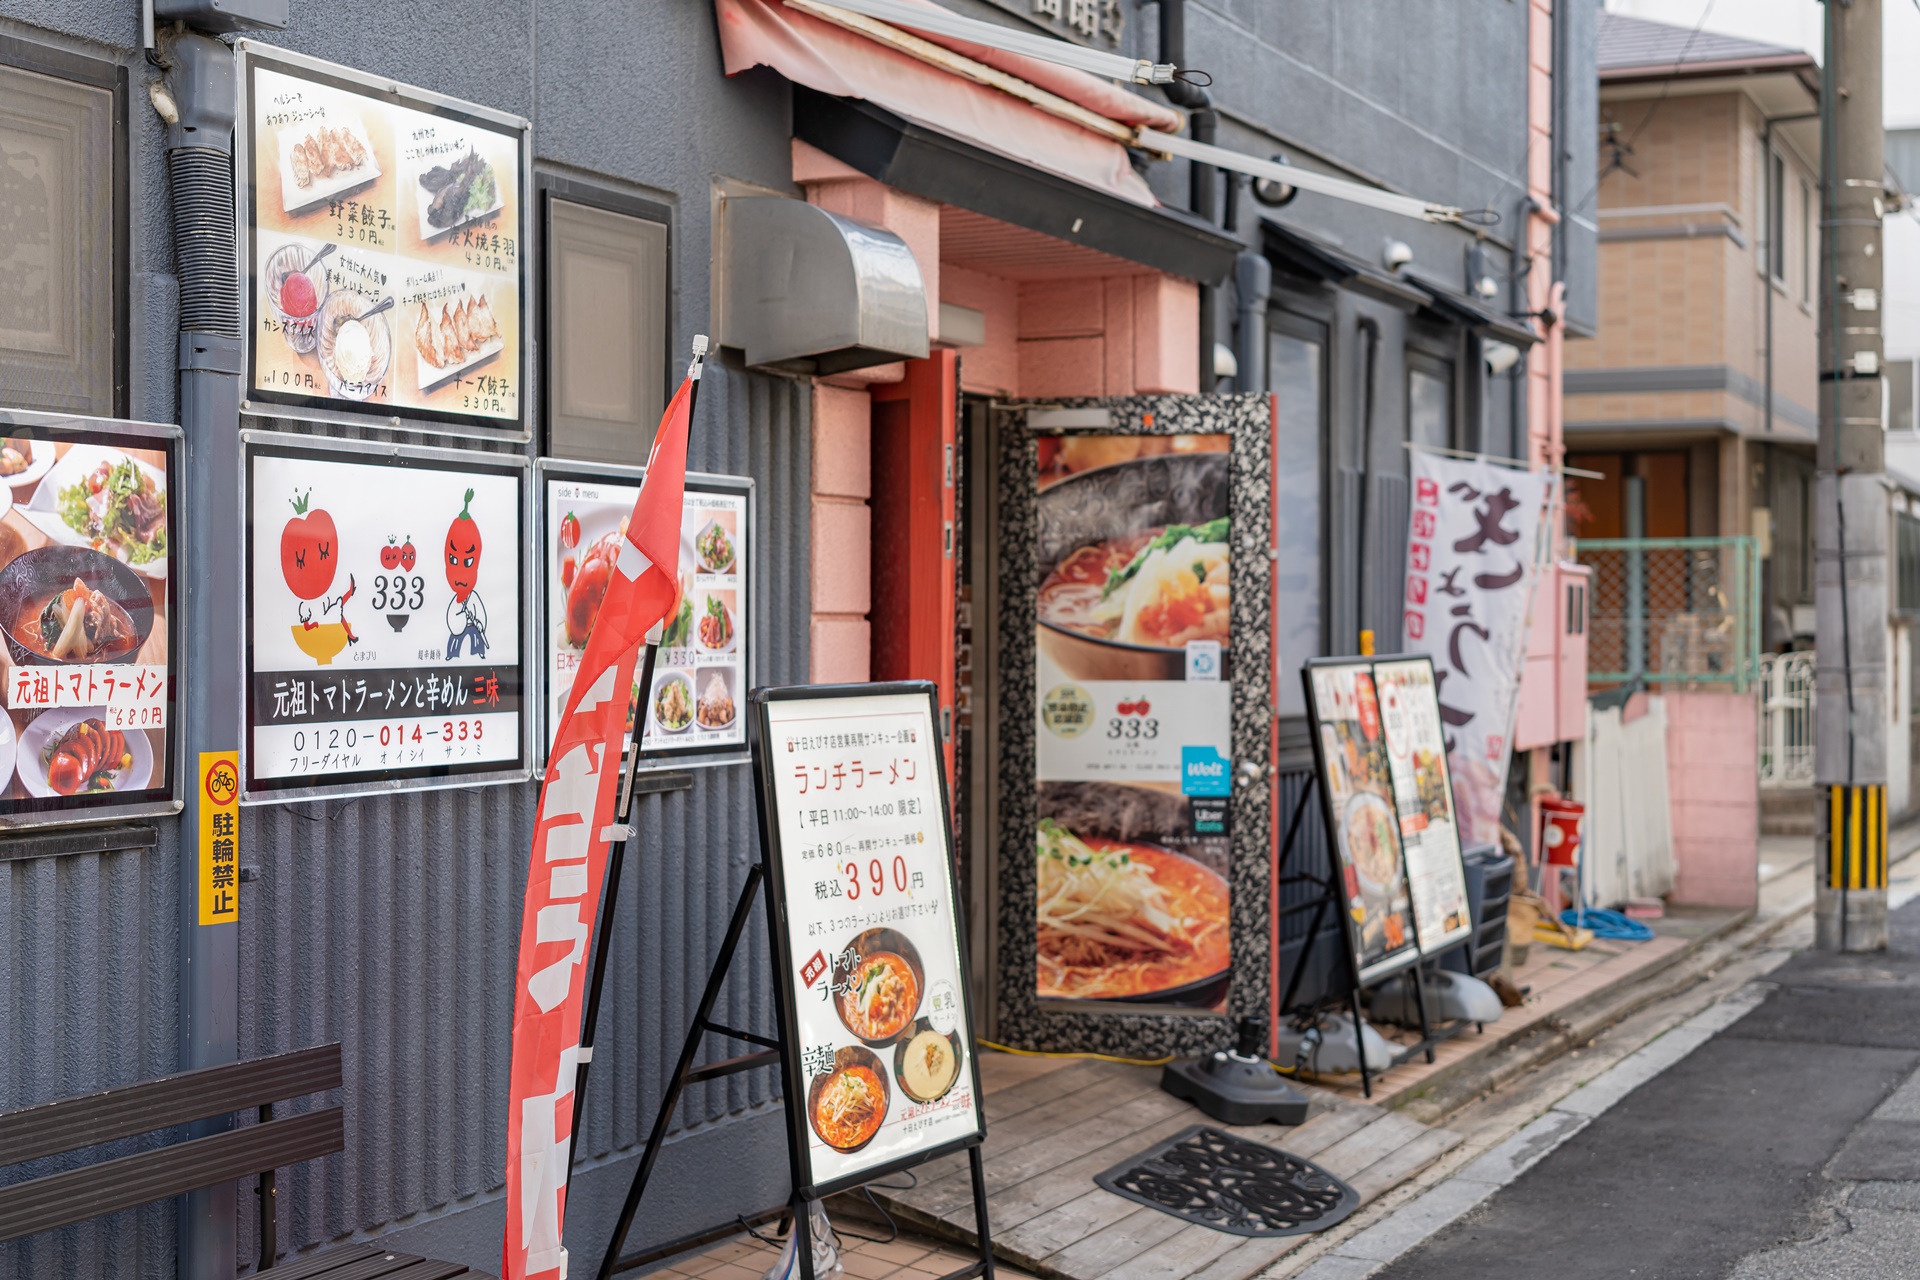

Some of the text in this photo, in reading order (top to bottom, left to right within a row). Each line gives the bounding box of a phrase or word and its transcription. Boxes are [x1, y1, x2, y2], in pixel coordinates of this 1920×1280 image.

[329, 199, 391, 230] 野菜餃子
[263, 317, 315, 338] カシスアイス
[557, 486, 599, 499] side menu
[371, 574, 425, 611] 333
[16, 668, 163, 704] 元祖トマトラーメン
[1106, 718, 1159, 740] 333
[290, 752, 361, 773] フリーダイヤル
[794, 758, 916, 794] ランチラーメン
[1187, 761, 1223, 777] Wolt
[212, 812, 234, 915] 駐輪禁止
[829, 947, 862, 975] トマト
[817, 975, 863, 1002] ラーメン
